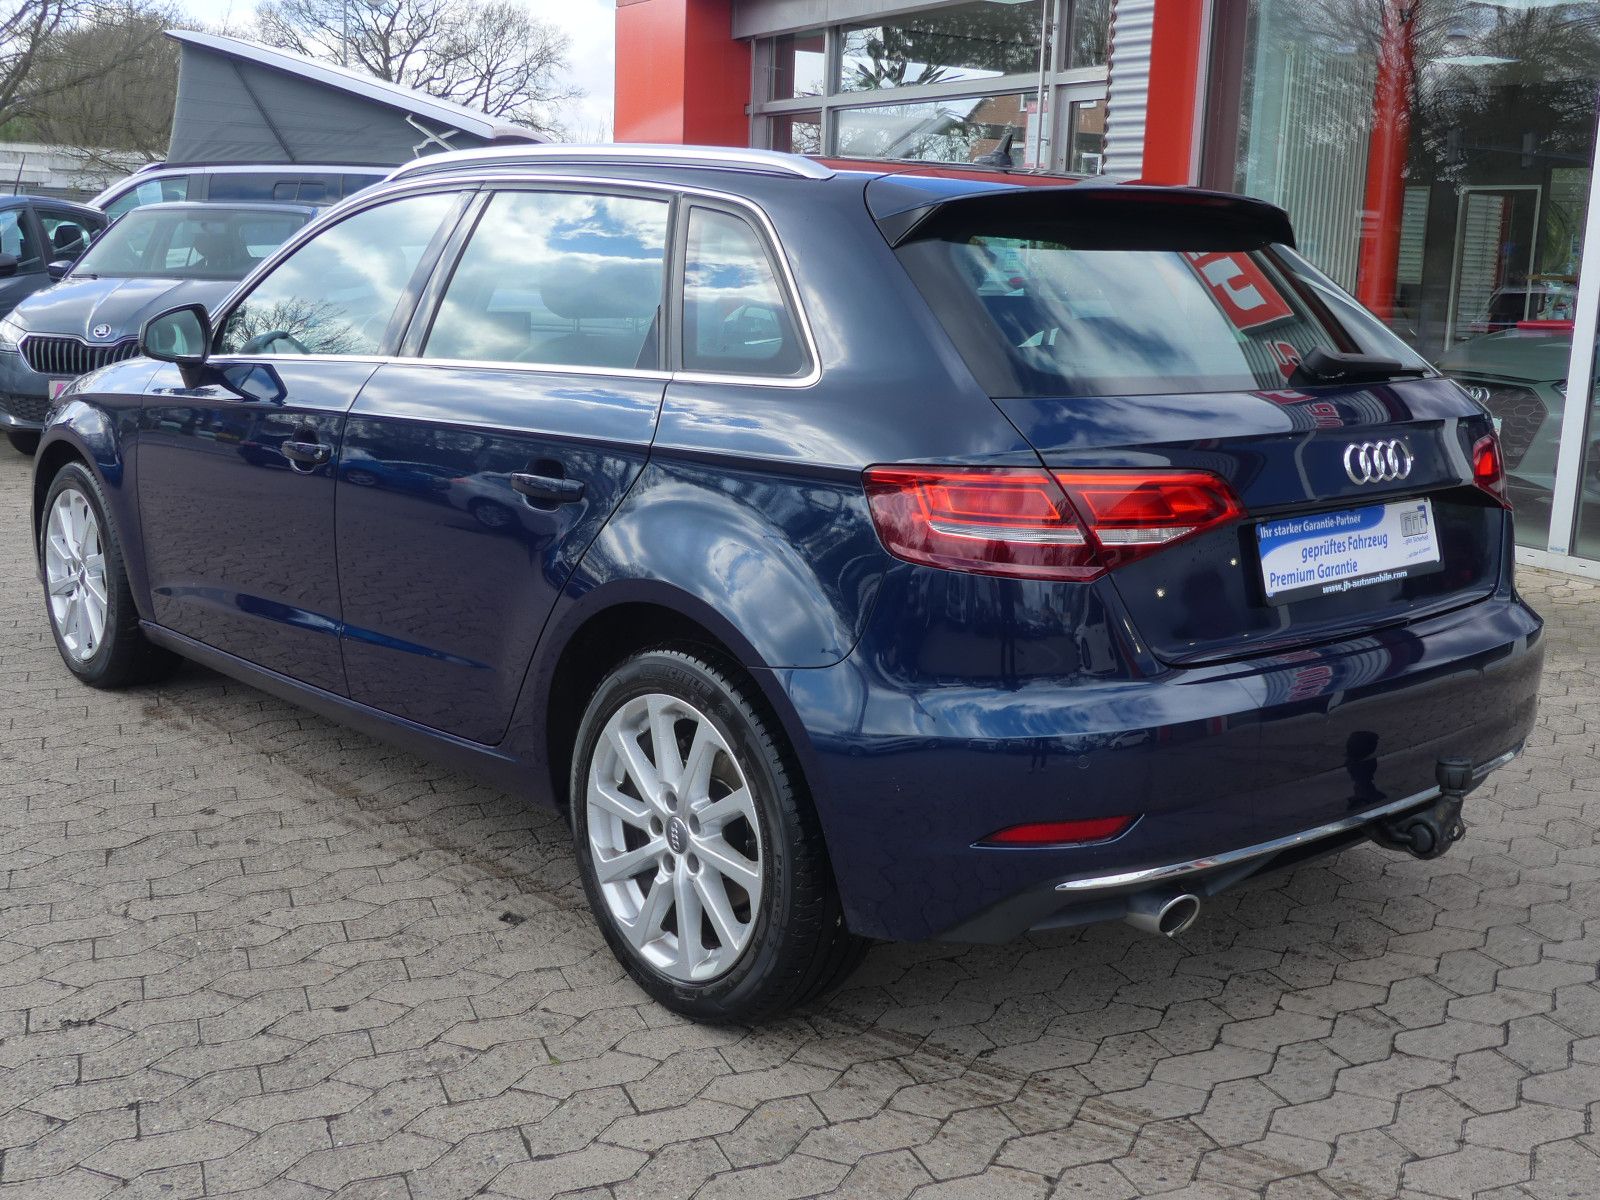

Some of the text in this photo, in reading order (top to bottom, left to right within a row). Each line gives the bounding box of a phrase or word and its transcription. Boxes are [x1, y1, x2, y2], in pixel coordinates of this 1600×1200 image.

[1260, 514, 1361, 538] Ihr starker Garantie-Partner
[1301, 539, 1346, 563] geprüftes
[1348, 533, 1388, 551] Fahrzeug
[1269, 558, 1358, 588] Premium Garantie
